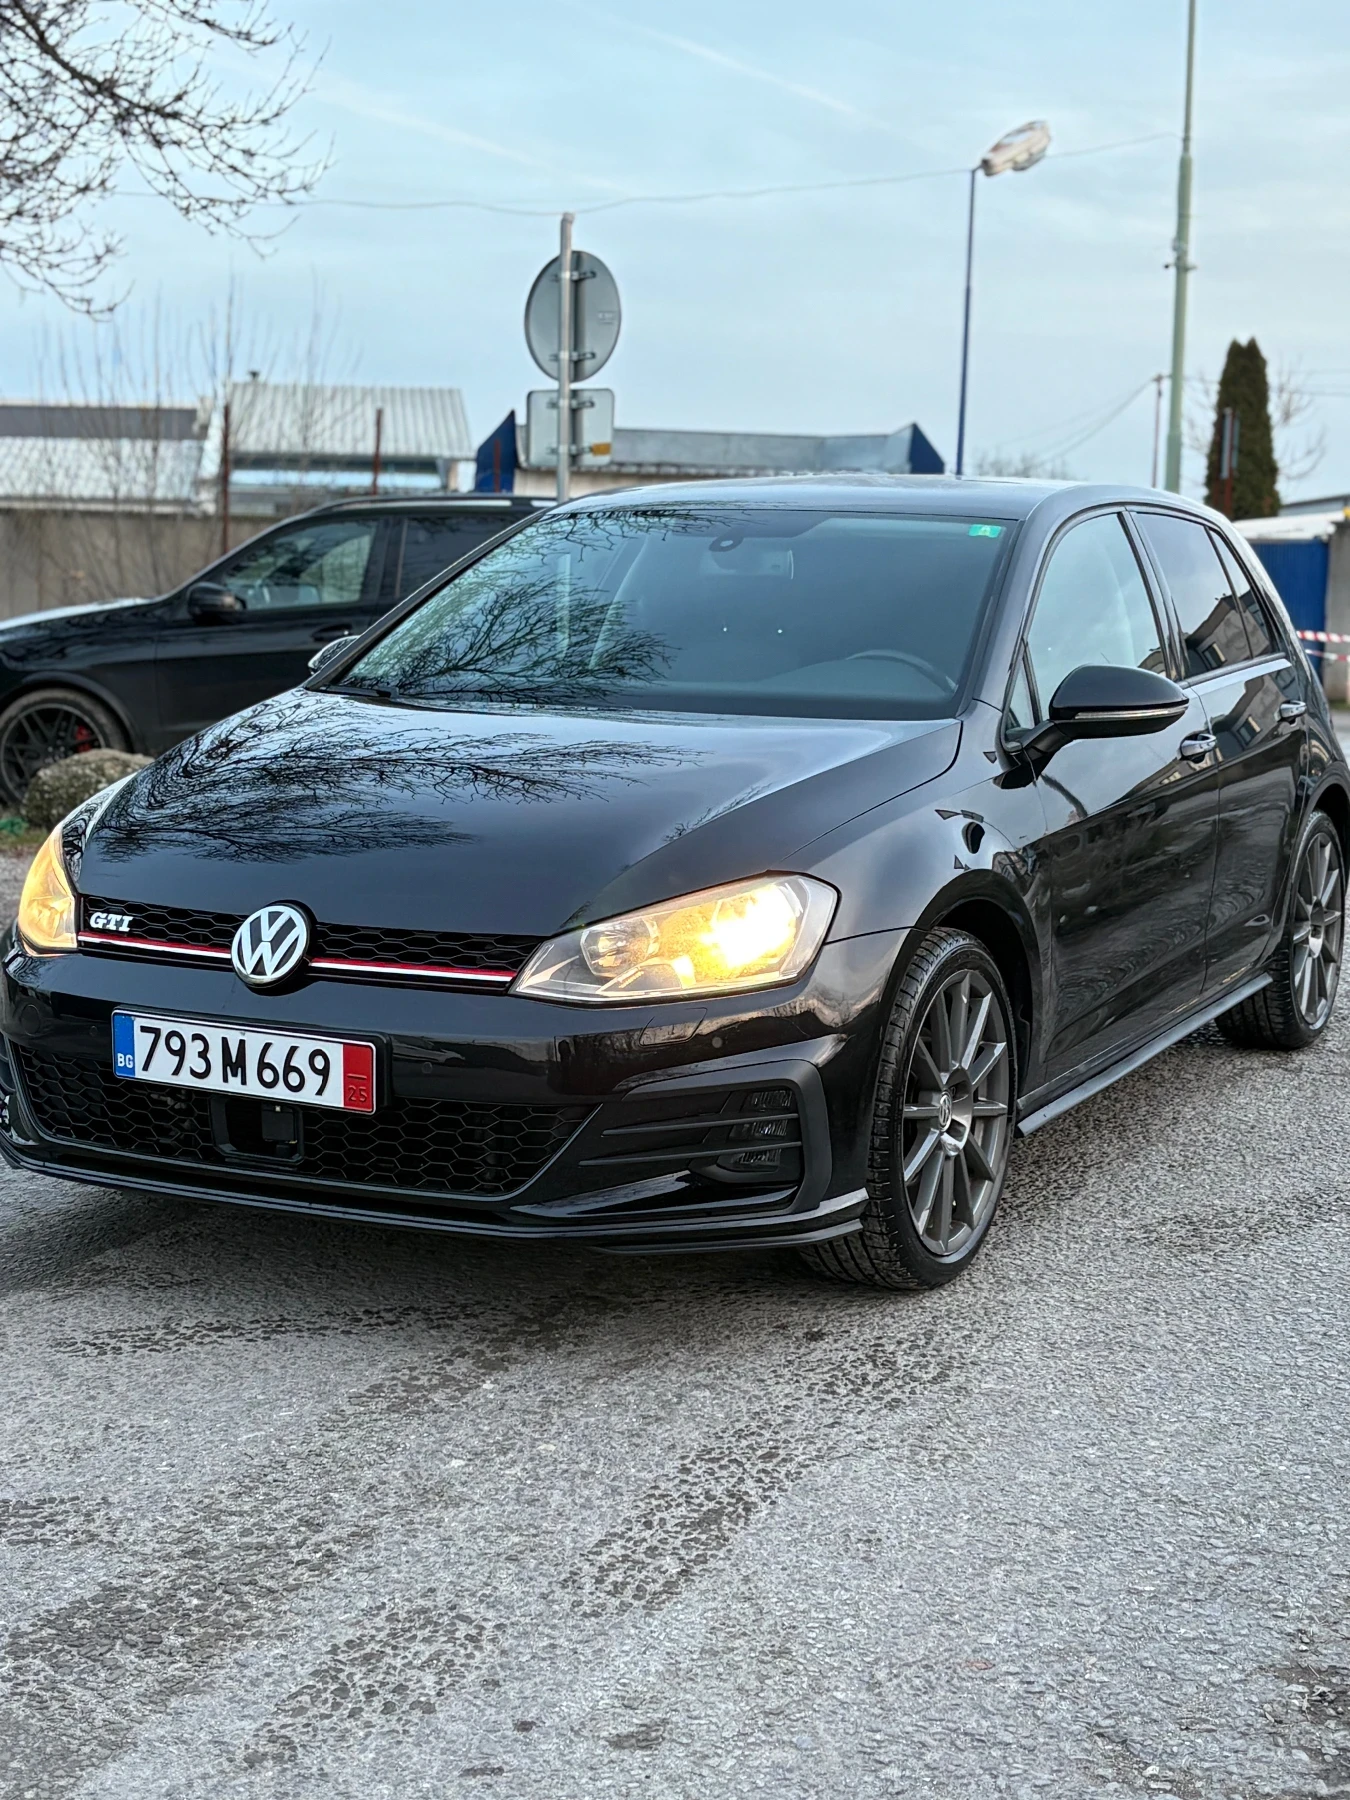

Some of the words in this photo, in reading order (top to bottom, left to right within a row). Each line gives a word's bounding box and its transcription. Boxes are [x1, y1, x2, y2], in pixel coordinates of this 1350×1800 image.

[89, 911, 134, 932] GTI
[232, 905, 307, 980] VW
[117, 1053, 134, 1069] BG
[140, 1025, 211, 1079] 793
[221, 1036, 247, 1086] M
[257, 1042, 331, 1096] 669
[347, 1085, 368, 1102] 25
